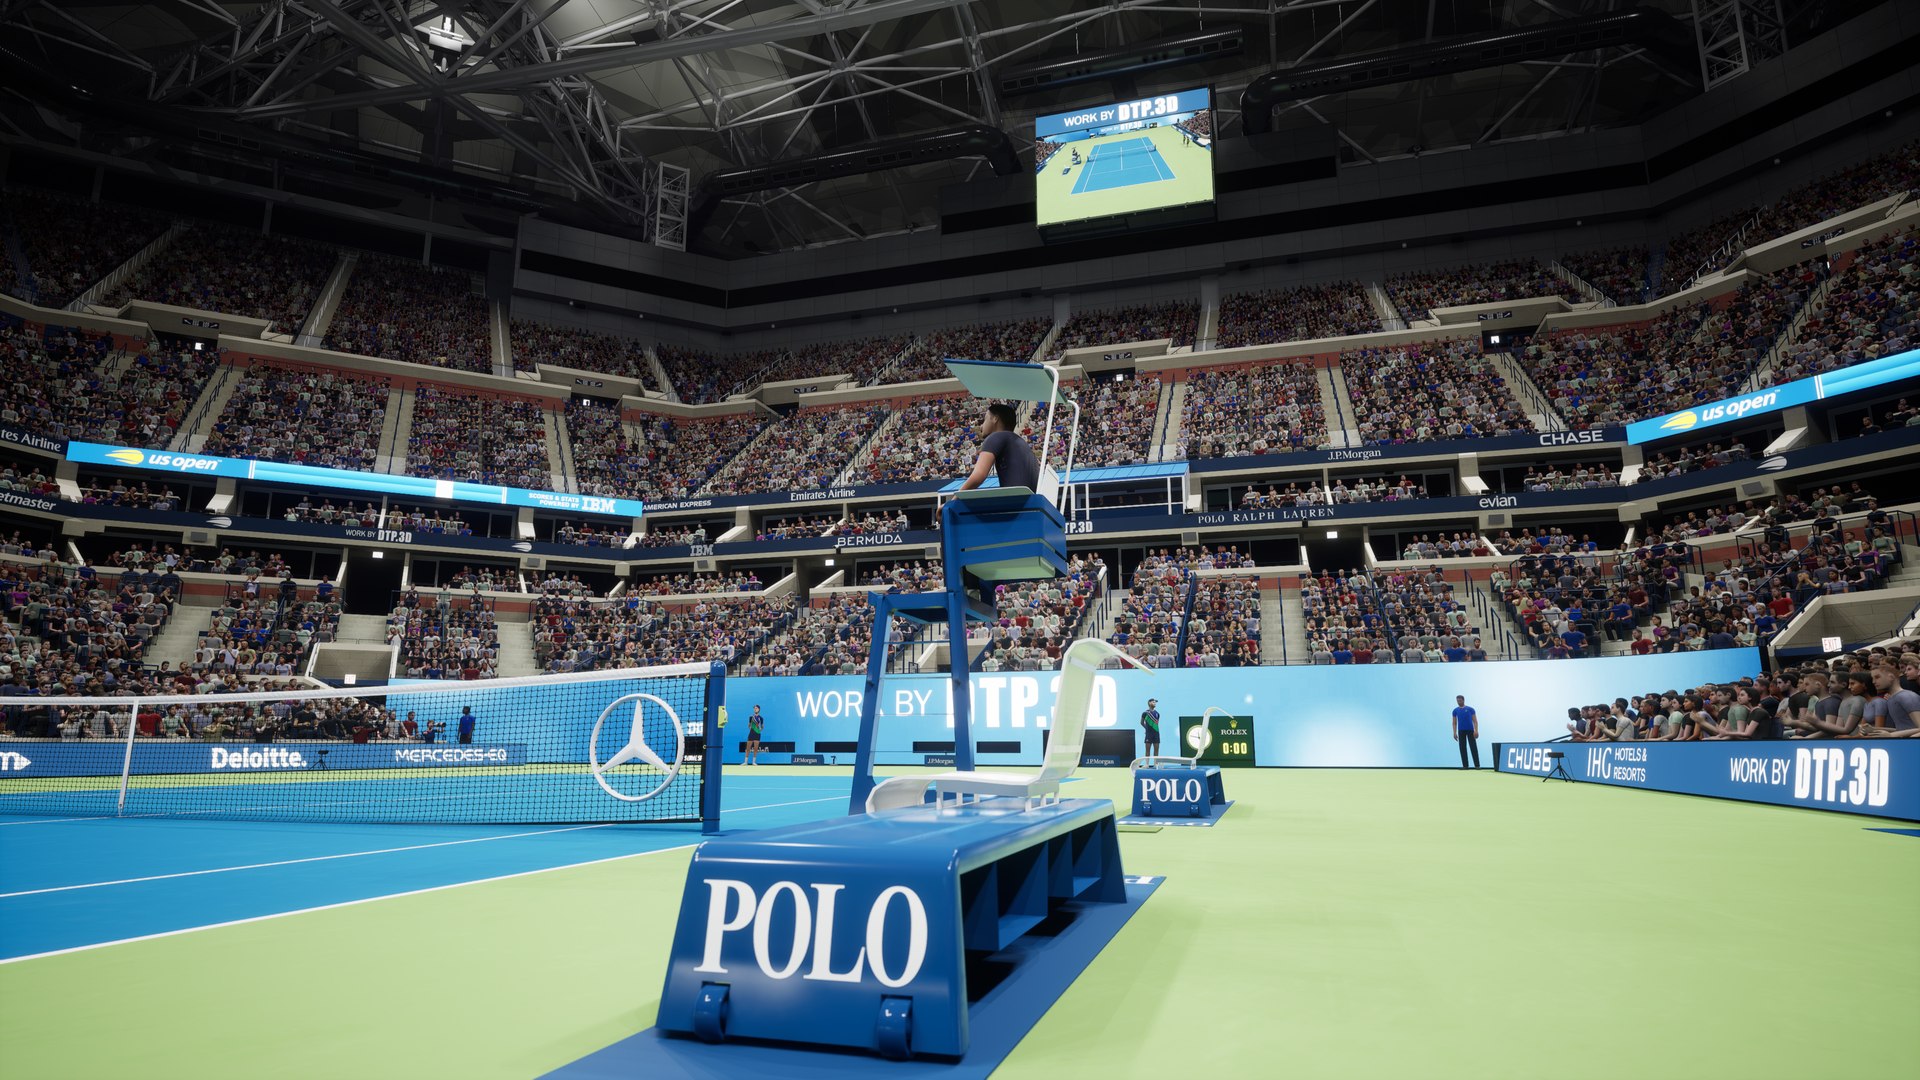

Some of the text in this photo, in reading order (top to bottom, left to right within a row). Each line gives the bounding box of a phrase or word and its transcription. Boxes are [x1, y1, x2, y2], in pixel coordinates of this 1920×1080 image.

[1064, 96, 1179, 127] WORK BY DTP.3D
[1702, 405, 1725, 421] us
[21, 433, 61, 452] Airline
[1539, 429, 1604, 445] CHASE
[149, 454, 172, 465] us
[1328, 449, 1382, 462] J.P.Morgan
[528, 492, 553, 501] SCORES
[561, 495, 579, 503] STATS
[790, 488, 856, 501] Emirates Airline
[1479, 494, 1517, 509] evian
[539, 499, 570, 508] POWERED
[581, 496, 616, 513] IBM
[642, 499, 712, 511] AMERICAN EXPRESS
[1197, 507, 1336, 524] POLO RALPH LAUREN
[1064, 521, 1093, 534] TP.3D
[345, 529, 412, 543] WORK BY DTP.3D
[837, 534, 903, 547] BERMUDA
[690, 543, 714, 557] IBM
[796, 690, 884, 718] WOR
[895, 690, 932, 716] BY
[395, 748, 507, 763] MERCEDES-EQ
[1222, 742, 1247, 754] 0:00
[1614, 747, 1647, 762] HOTELS &
[1507, 747, 1552, 772] CHUBB
[1587, 747, 1612, 779] IHG
[1613, 766, 1646, 782] RESORTS
[1730, 747, 1889, 807] WORK BY DTP.3D
[1140, 778, 1202, 803] POLO
[692, 878, 929, 988] POLO
